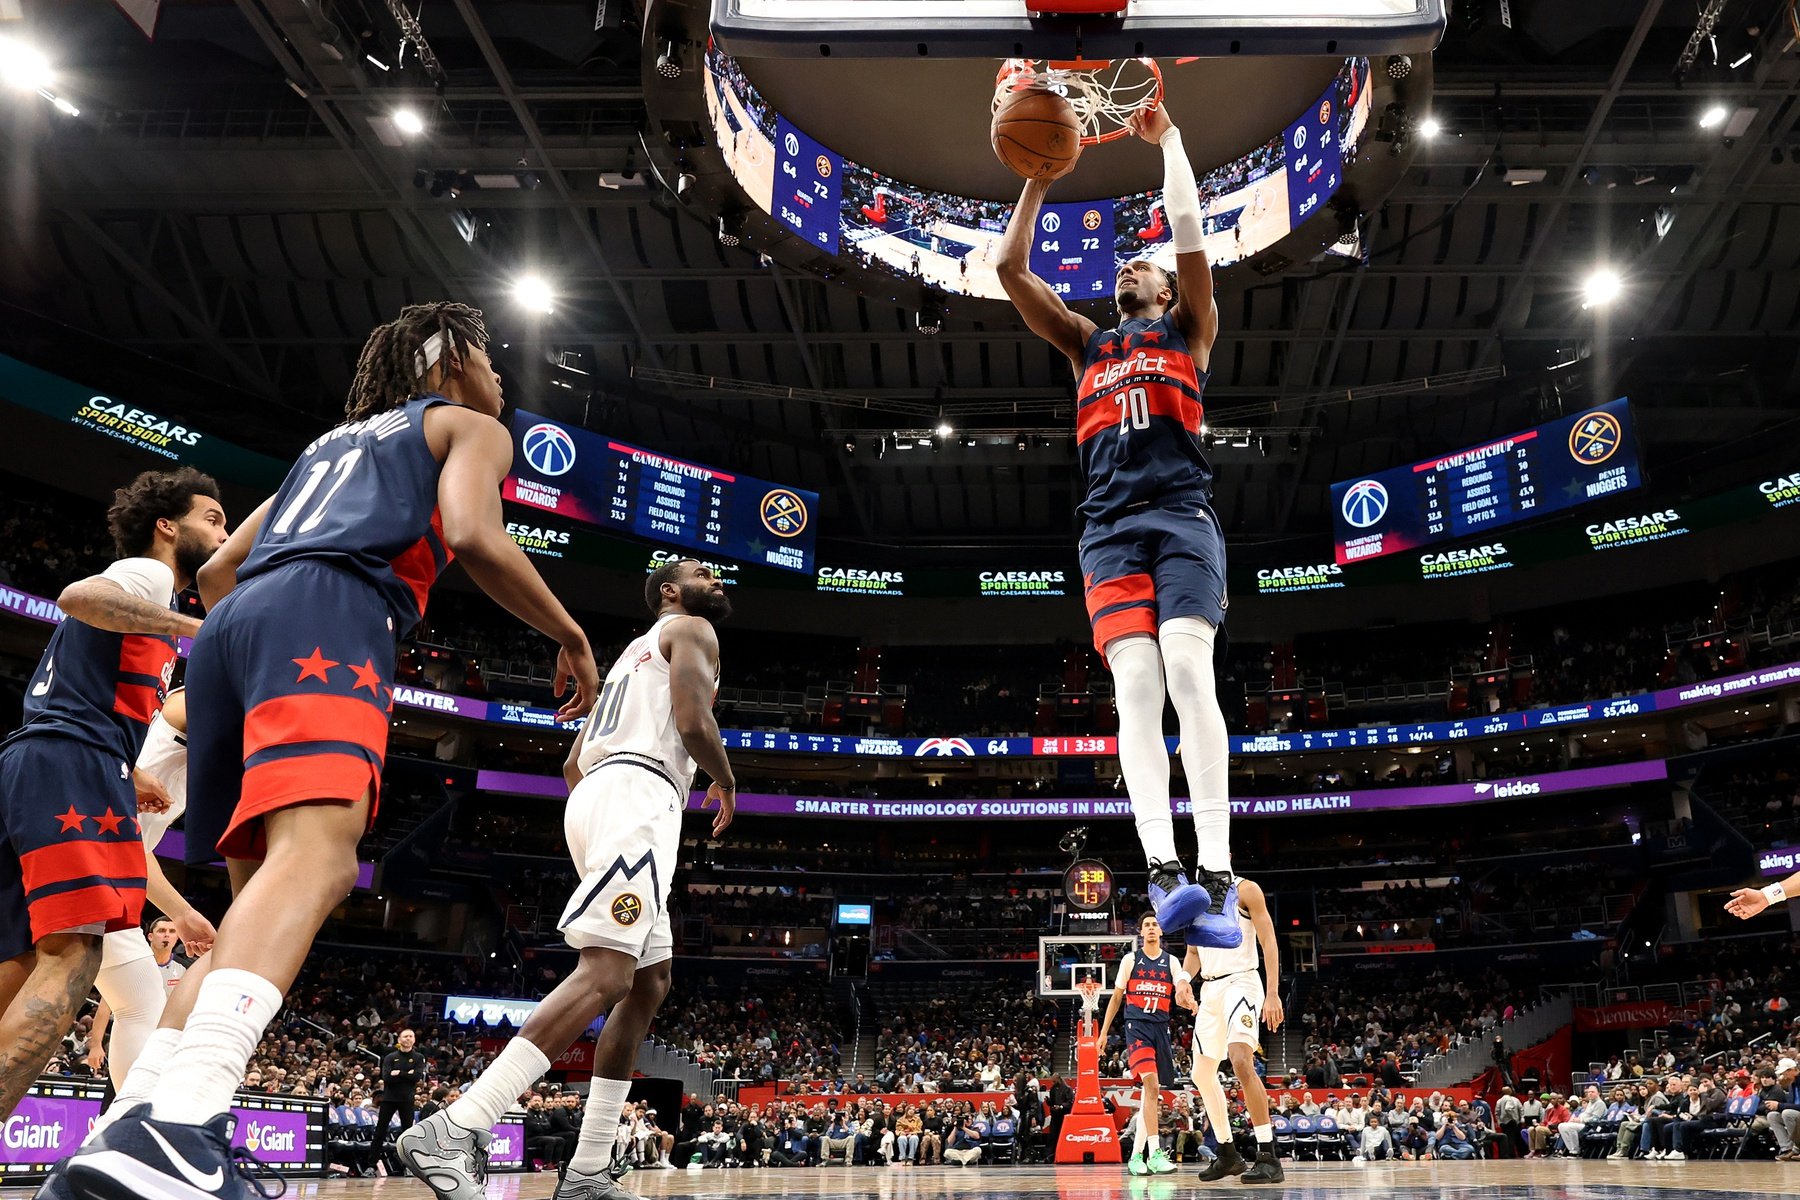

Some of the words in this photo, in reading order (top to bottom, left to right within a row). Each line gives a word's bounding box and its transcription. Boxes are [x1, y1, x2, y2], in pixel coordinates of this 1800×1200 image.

[1320, 130, 1331, 148] 72
[783, 160, 797, 178] 64
[1295, 154, 1308, 172] 64
[813, 180, 828, 199] 72
[1299, 193, 1317, 216] 3:38
[781, 206, 802, 228] 3:38
[1041, 241, 1060, 252] 64
[1081, 238, 1100, 250] 72
[1091, 280, 1103, 291] :5
[1093, 351, 1168, 389] district
[88, 395, 202, 446] CAESARS
[1114, 387, 1150, 436] 20
[77, 406, 172, 447] SPORTSBOOK
[70, 415, 95, 429] WITH
[96, 425, 137, 444] CAESARS
[137, 439, 179, 460] REWARDS
[1436, 454, 1465, 471] GAME
[1466, 440, 1514, 463] MATCHUP
[632, 451, 662, 468] GAME
[662, 460, 713, 481] MATCHUP
[1465, 460, 1487, 473] POINTS
[660, 471, 682, 484] POINTS
[1461, 471, 1493, 487] REBOUNDS
[1586, 475, 1627, 497] NUGGETS
[272, 448, 362, 534] 12
[518, 477, 561, 497] WASHINGTON
[654, 481, 686, 497] REBOUNDS
[1467, 484, 1491, 499] ASSISTS
[516, 486, 558, 509] WIZARDS
[656, 495, 680, 509] ASSISTS
[1462, 501, 1477, 512] FIELD
[1477, 498, 1492, 509] GOAL
[648, 506, 663, 517] FIELD
[664, 509, 679, 522] GOAL
[1586, 509, 1678, 536] CAESARS
[1590, 523, 1667, 545] SPORTSBOOK
[1593, 543, 1613, 551] WITH
[1614, 536, 1648, 547] CAESARS
[1649, 528, 1688, 540] REWARDS
[526, 546, 563, 558] REWARDS
[766, 551, 803, 569] NUGGETS
[1345, 542, 1382, 560] WIZARDS
[1420, 543, 1506, 565] CAESARS
[1257, 563, 1342, 580] CAESARS
[1422, 556, 1495, 574] SPORTSBOOK
[817, 577, 888, 589] SPORTSBOOK
[818, 567, 903, 582] CAESARS
[979, 571, 1064, 582] CAESARS
[1258, 575, 1328, 588] SPORTSBOOK
[980, 582, 1049, 590] SPORTSBOOK
[1680, 684, 1721, 700] making
[1723, 675, 1757, 691] smart
[588, 673, 630, 742] 10
[1603, 703, 1639, 718] $5,440
[1043, 739, 1058, 747] 3rd
[1304, 740, 1311, 748] 6
[1327, 739, 1332, 747] 1
[1367, 736, 1378, 744] 35
[1387, 734, 1398, 742] 18
[1409, 732, 1433, 741] 14/14
[1449, 728, 1468, 738] 8/21
[1484, 723, 1508, 733] 25/57
[741, 738, 751, 747] 13
[764, 740, 775, 749] 38
[788, 742, 798, 750] 10
[812, 743, 818, 751] 5
[833, 744, 839, 752] 2
[855, 743, 903, 755] WIZARDS
[987, 740, 1008, 754] 64
[1075, 739, 1105, 752] 3:38
[1242, 740, 1291, 752] NUGGETS
[1493, 780, 1540, 798] leidos
[795, 800, 869, 815] SMARTER
[872, 803, 978, 816] TECHNOLOGY
[981, 802, 1069, 815] SOLUTIONS
[1072, 802, 1089, 814] IN
[1253, 800, 1288, 813] AND
[1291, 796, 1351, 811] HEALTH
[1760, 854, 1794, 869] aking
[1080, 870, 1105, 883] 3:38
[1075, 883, 1098, 904] 4.3
[1143, 997, 1159, 1014] 27
[1594, 1007, 1660, 1025] Hennessy
[4, 1115, 63, 1149] Giant
[261, 1125, 295, 1151] Giant
